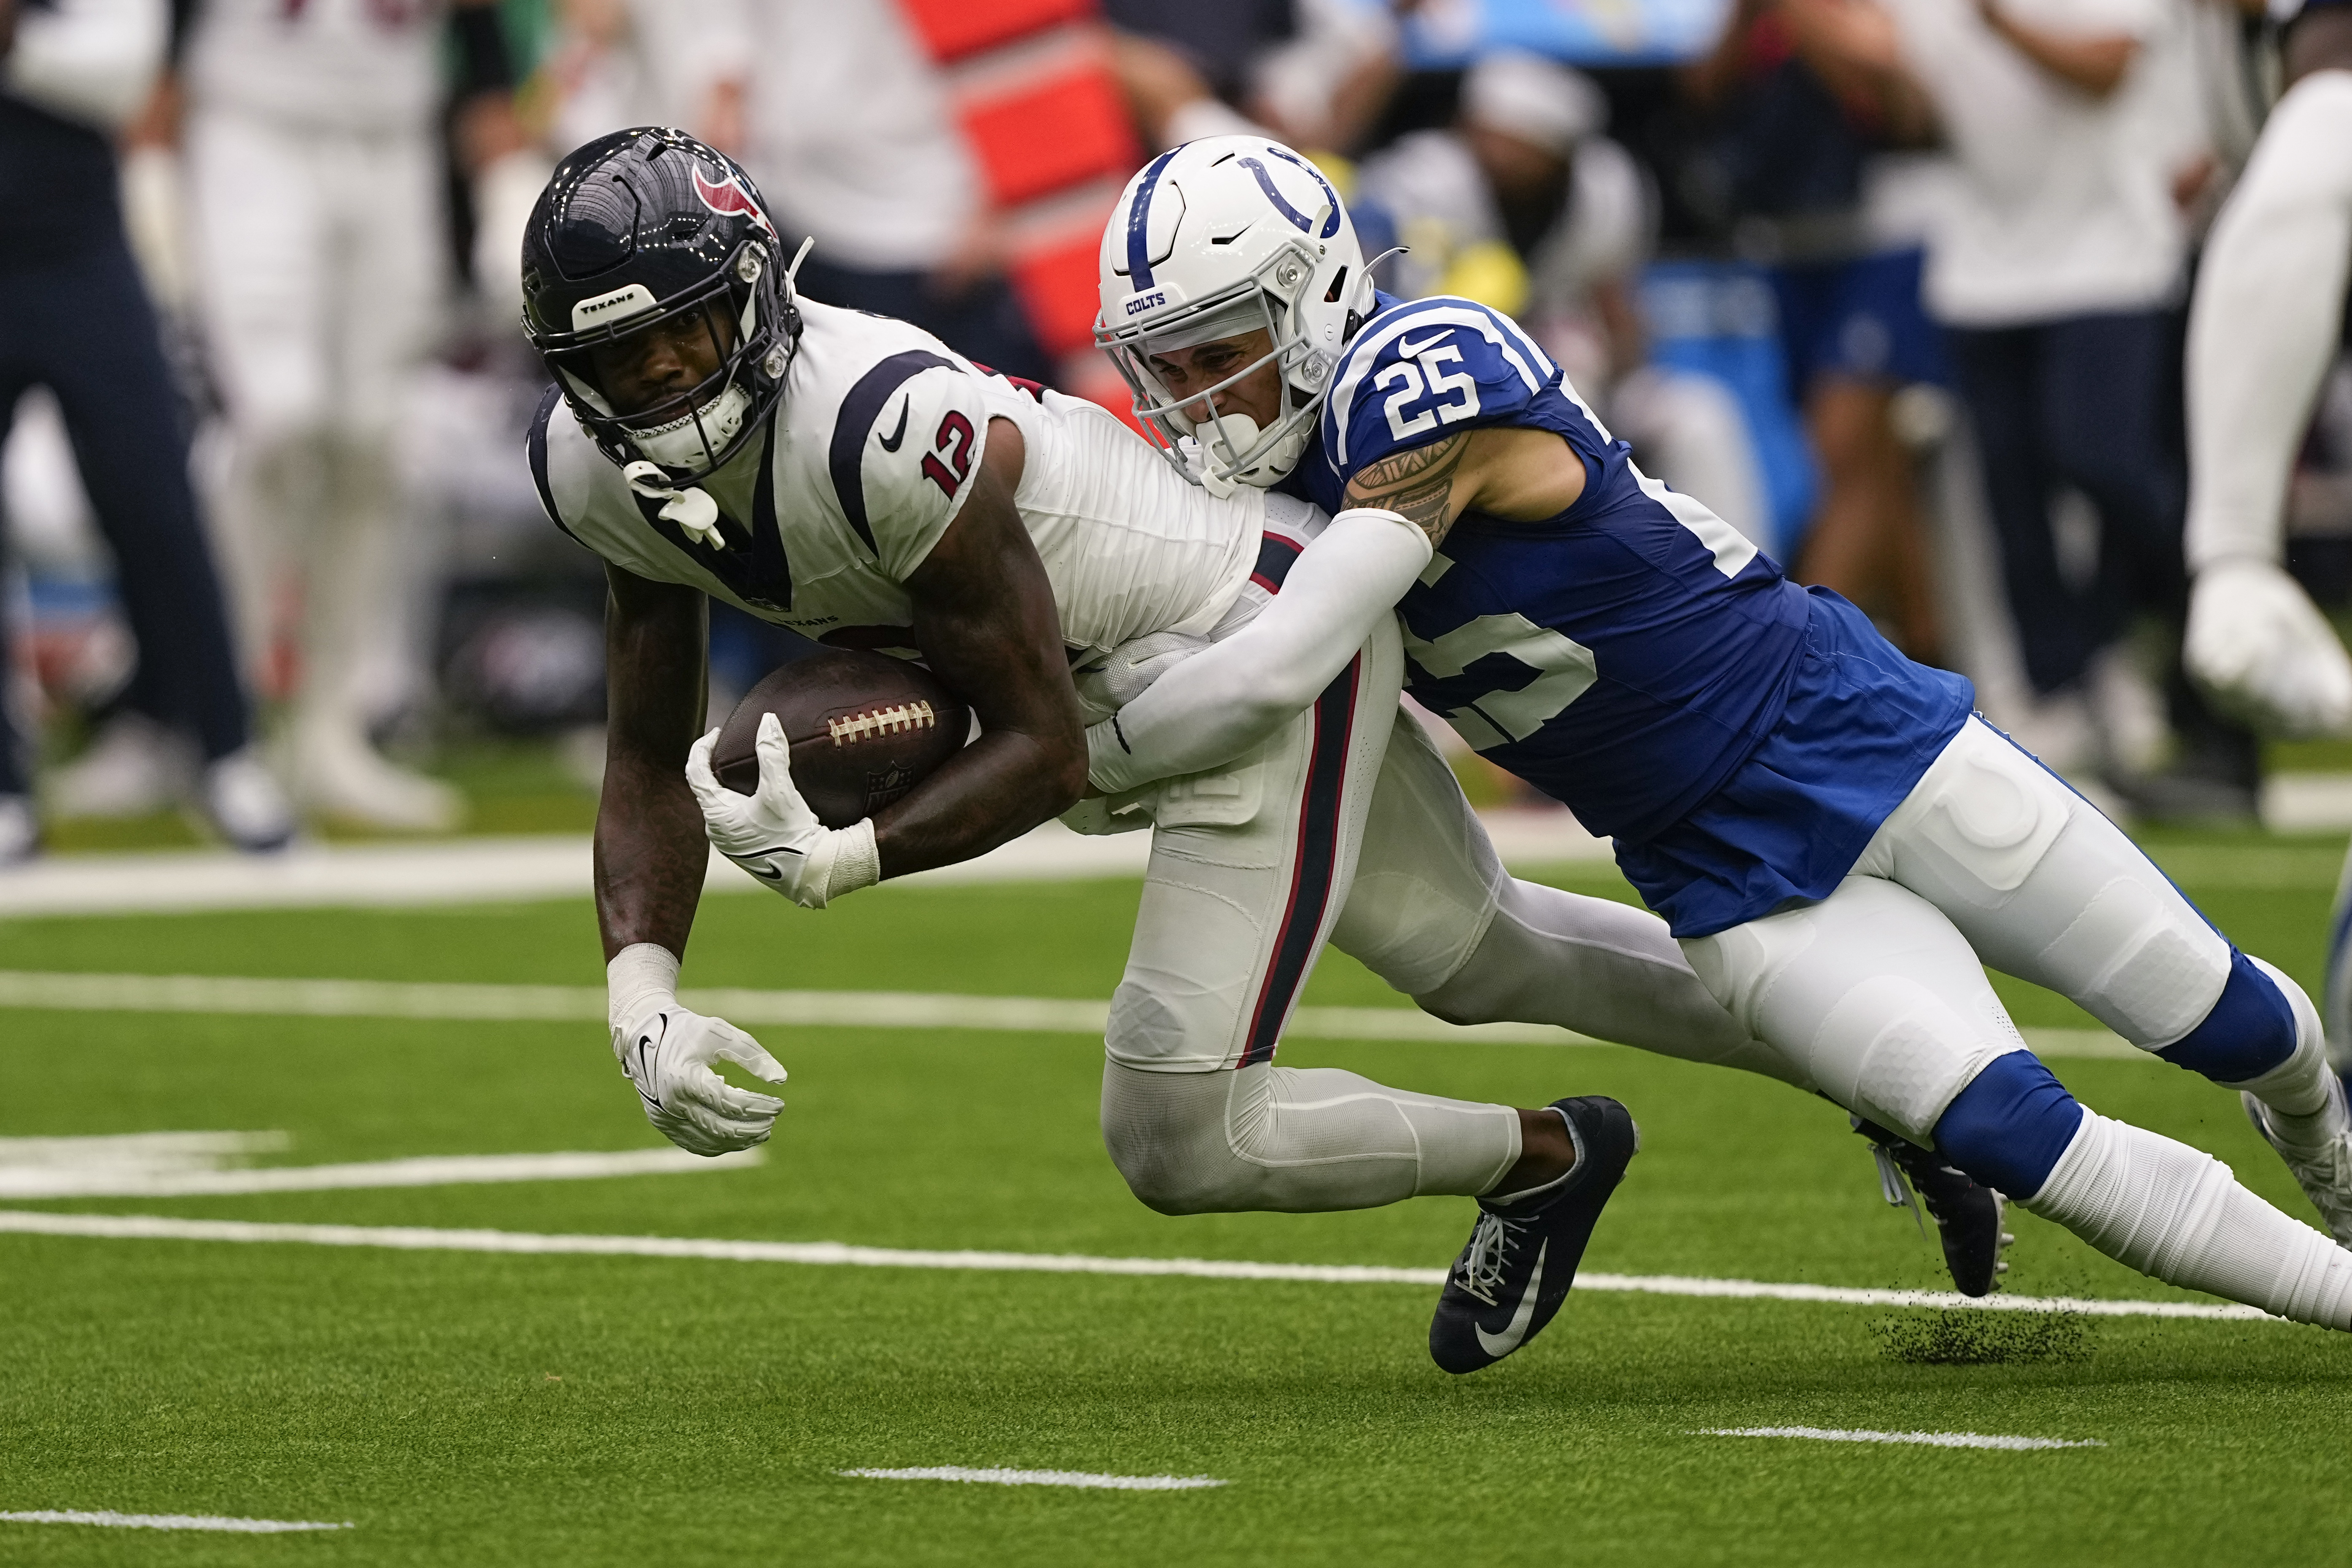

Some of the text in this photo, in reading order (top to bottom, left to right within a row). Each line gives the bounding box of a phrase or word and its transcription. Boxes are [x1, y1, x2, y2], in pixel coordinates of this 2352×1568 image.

[580, 292, 634, 315] TEXANS
[1125, 292, 1166, 316] COLTS
[1373, 344, 1481, 441] 25
[921, 409, 974, 503] 12
